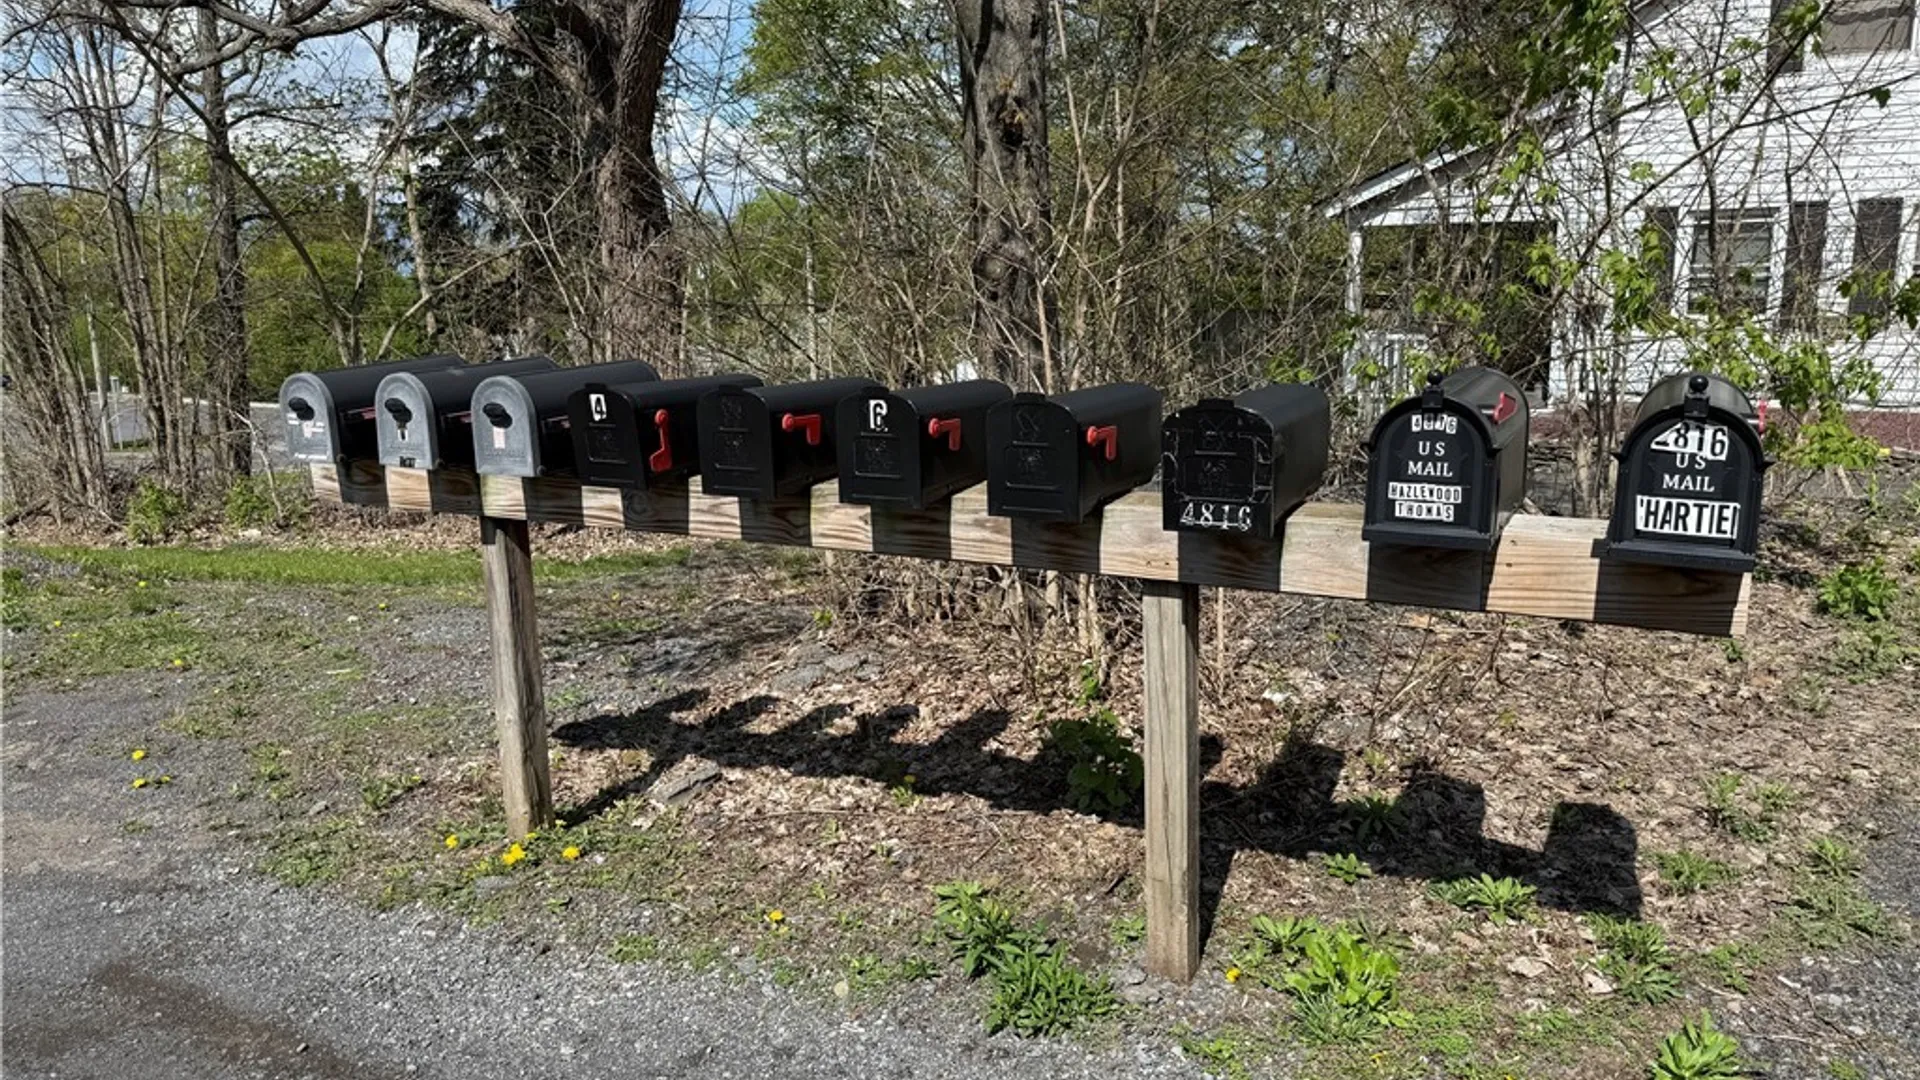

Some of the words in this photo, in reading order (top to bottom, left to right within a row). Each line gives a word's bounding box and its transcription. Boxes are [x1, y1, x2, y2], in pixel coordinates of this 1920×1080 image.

[1418, 441, 1430, 455] U
[1434, 441, 1446, 456] S
[1652, 421, 1728, 458] 816
[1407, 460, 1453, 477] MAIL
[1662, 474, 1715, 492] MAIL
[1390, 484, 1461, 502] HAZLEWOOD
[1180, 501, 1252, 532] 4816
[1396, 502, 1454, 520] THOMAS
